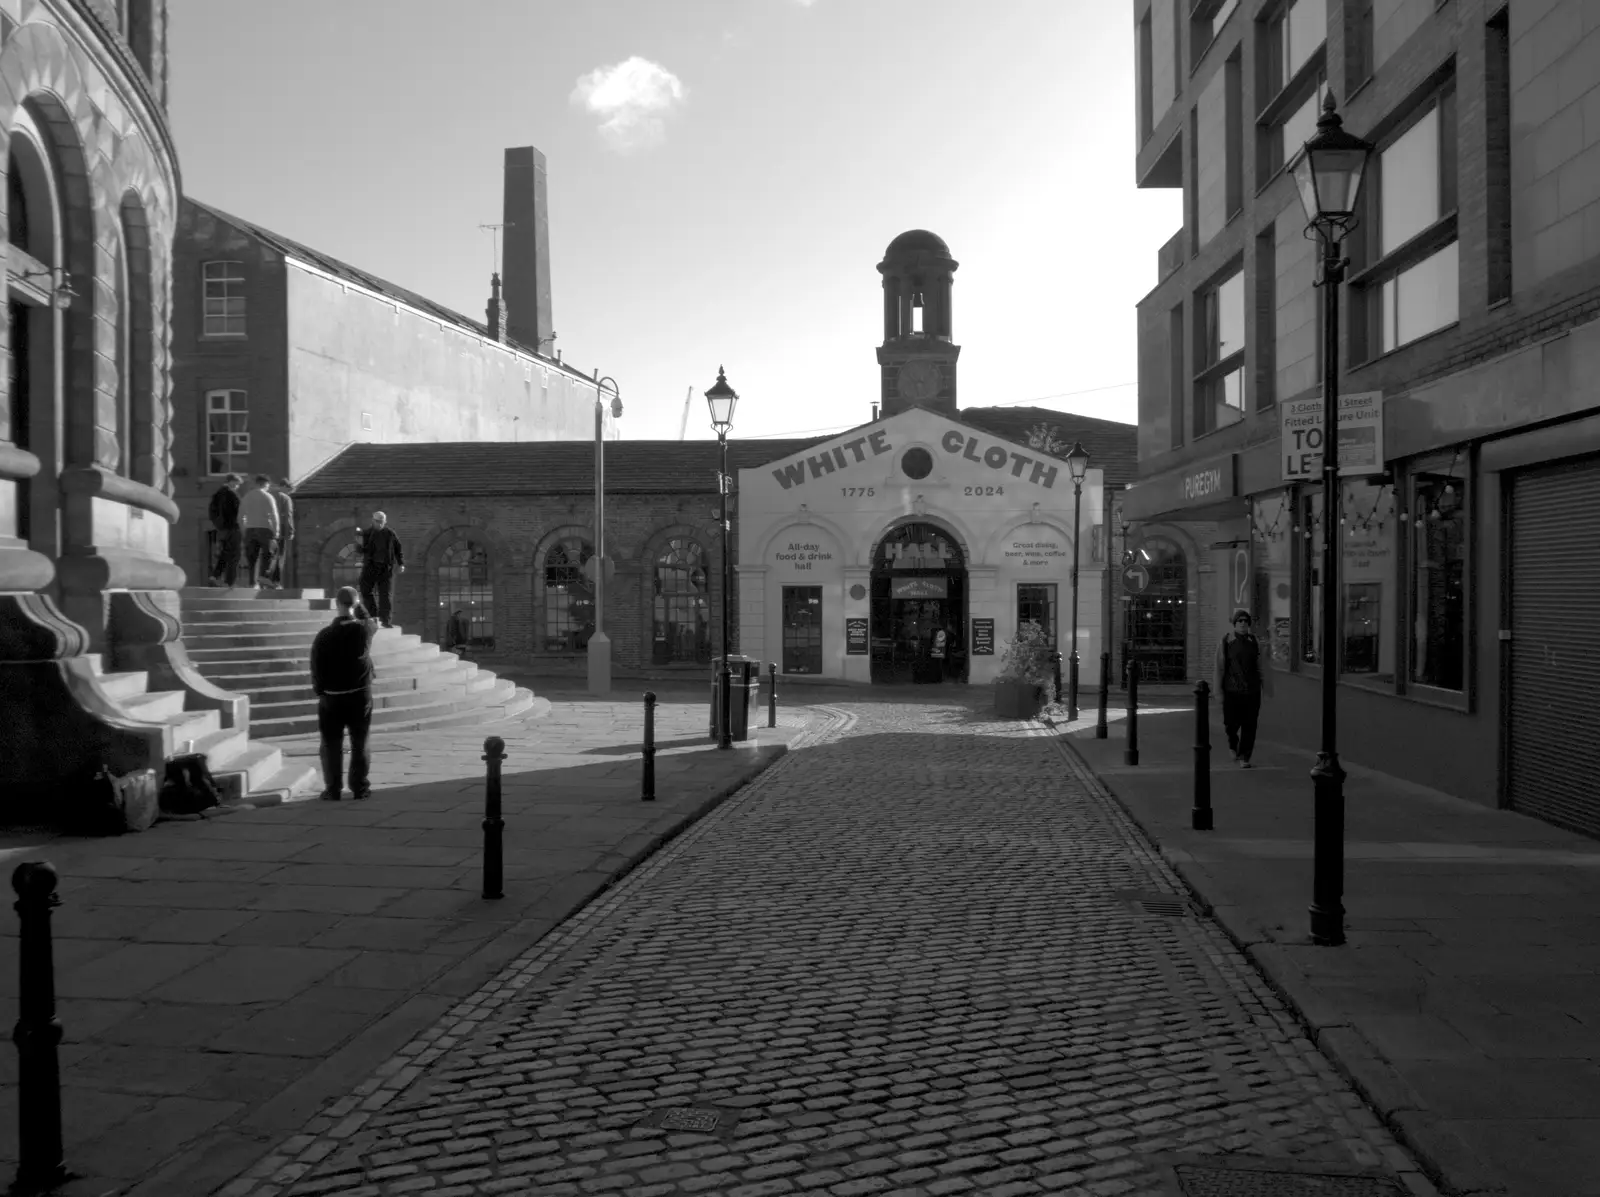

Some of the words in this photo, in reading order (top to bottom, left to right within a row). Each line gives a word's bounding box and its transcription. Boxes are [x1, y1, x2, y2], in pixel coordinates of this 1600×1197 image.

[1298, 402, 1322, 411] Cloth
[1344, 397, 1372, 407] Street
[1285, 416, 1314, 427] Fitted
[1292, 428, 1323, 450] TO
[772, 428, 892, 489] WHITE
[942, 430, 1058, 489] CLOTH
[1287, 453, 1323, 475] LE
[1185, 468, 1221, 500] PUREGYM
[841, 487, 875, 497] 1775
[964, 486, 1004, 496] 2024
[788, 543, 819, 552] All-day
[885, 543, 952, 559] HALL
[776, 553, 796, 561] food
[808, 552, 832, 560] drink
[795, 562, 812, 570] hall
